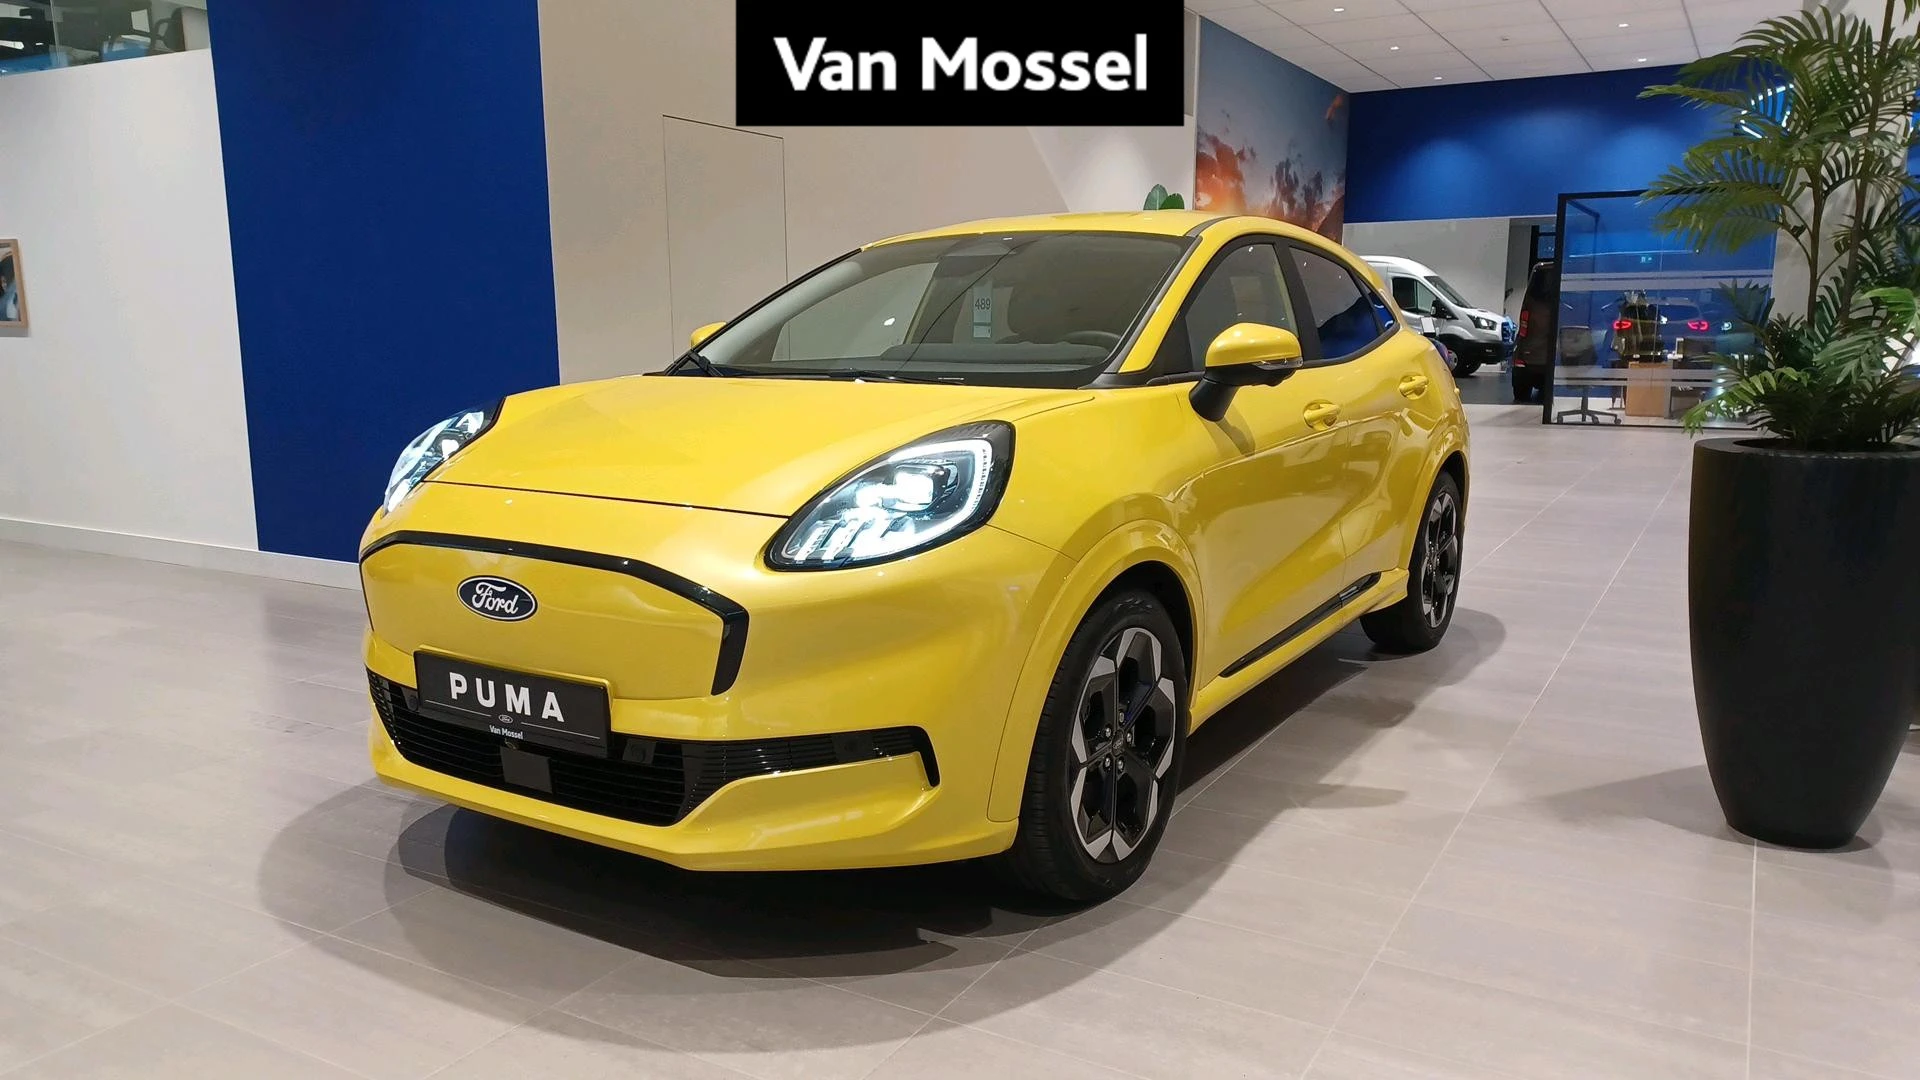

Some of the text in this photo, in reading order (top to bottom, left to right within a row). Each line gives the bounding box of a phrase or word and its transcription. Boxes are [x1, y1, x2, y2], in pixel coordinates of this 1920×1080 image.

[975, 298, 991, 310] 489
[472, 581, 519, 615] Ford
[449, 672, 564, 722] PUMA
[489, 724, 523, 740] Van Mossel
